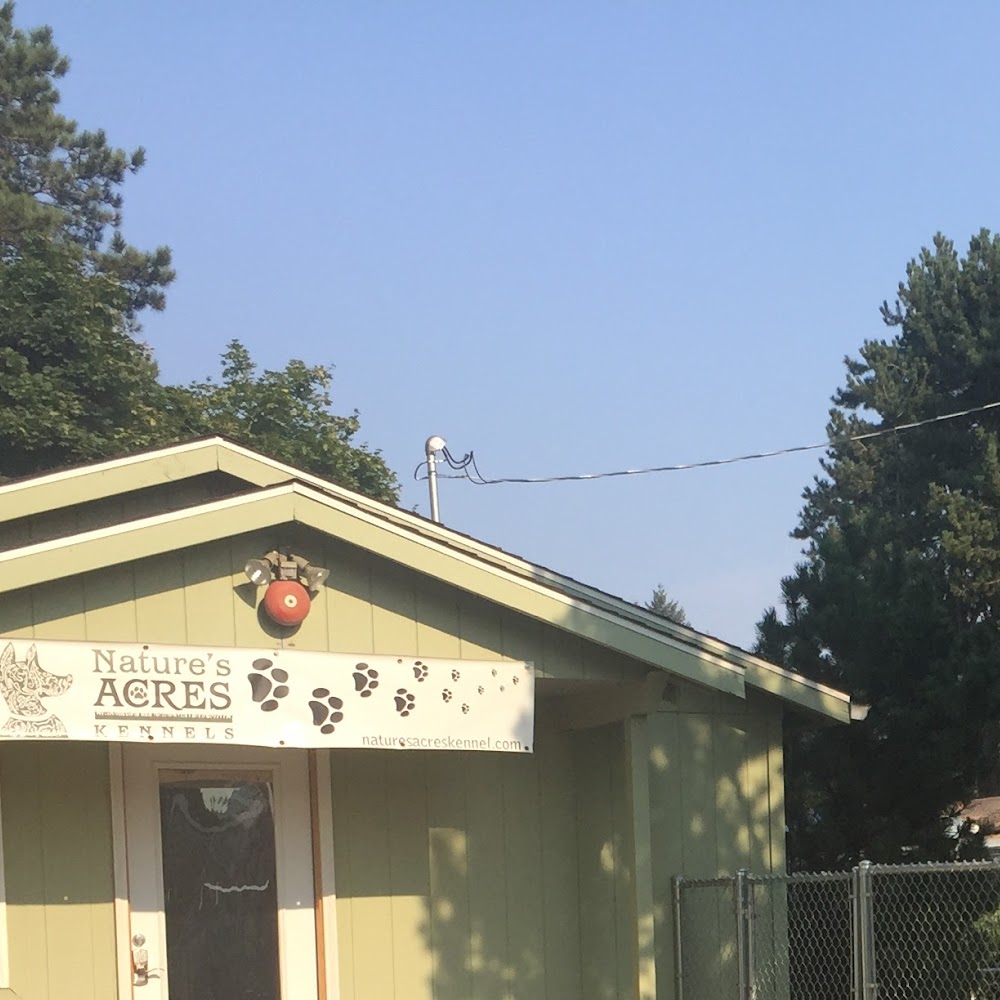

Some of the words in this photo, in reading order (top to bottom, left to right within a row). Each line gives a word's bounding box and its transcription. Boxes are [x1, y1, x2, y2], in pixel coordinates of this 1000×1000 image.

[91, 648, 232, 676] Nature's
[93, 678, 232, 711] ACRES
[94, 724, 235, 740] KENNELS
[362, 735, 522, 750] naturesacreskennel.com
